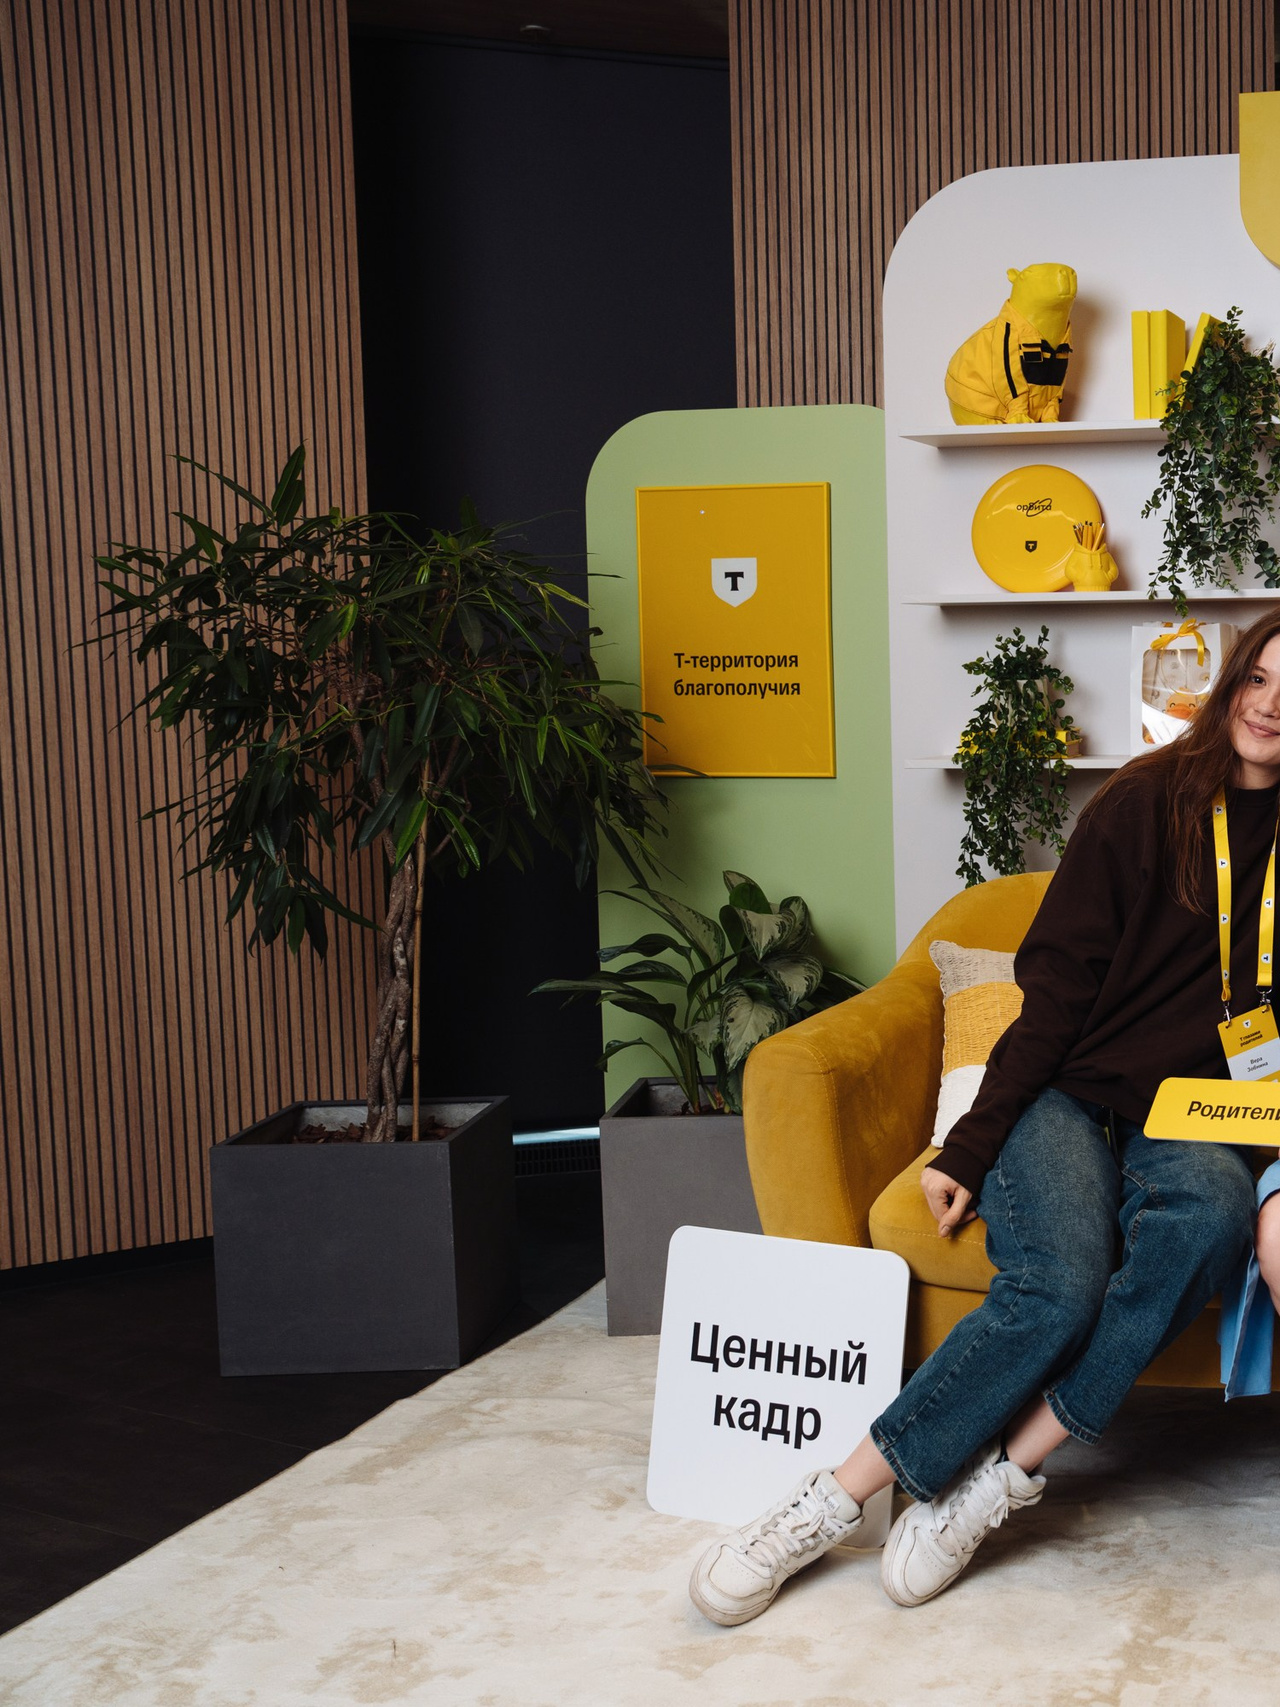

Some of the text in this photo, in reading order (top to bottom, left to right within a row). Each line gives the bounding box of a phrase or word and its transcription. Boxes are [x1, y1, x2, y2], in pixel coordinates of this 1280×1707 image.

[724, 571, 744, 591] Т
[674, 653, 799, 672] Т-территория
[674, 679, 801, 699] благополучия
[690, 1322, 868, 1385] Ценный
[713, 1394, 822, 1450] кадр
